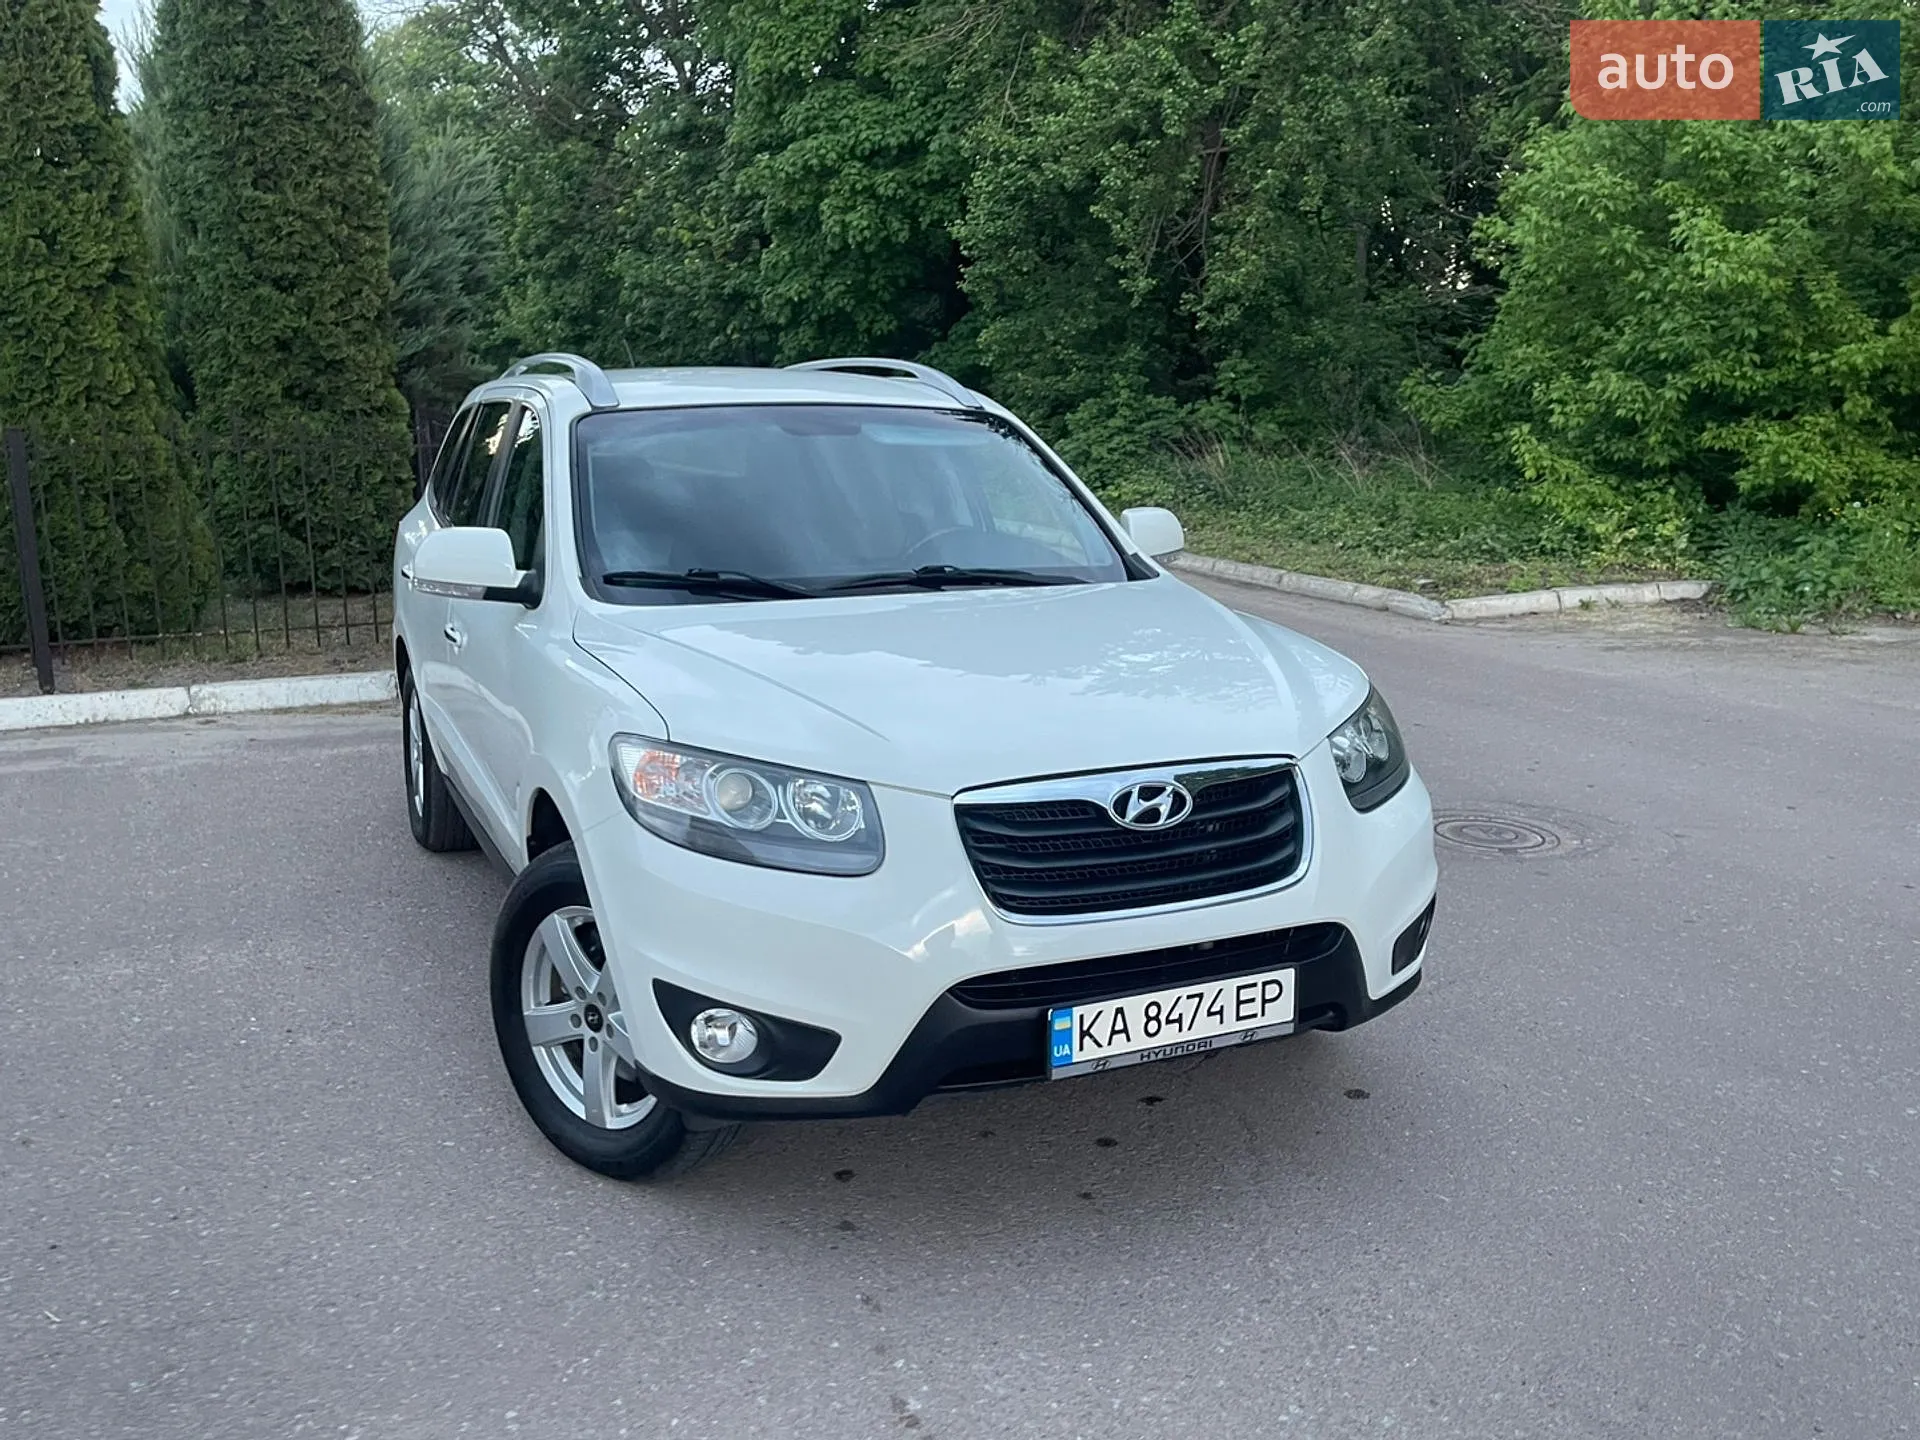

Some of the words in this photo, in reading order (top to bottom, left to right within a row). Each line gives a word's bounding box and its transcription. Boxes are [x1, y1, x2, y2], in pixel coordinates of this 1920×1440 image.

[1078, 1006, 1131, 1052] KA
[1143, 988, 1224, 1039] 8474
[1235, 978, 1283, 1023] EP
[1053, 1044, 1071, 1057] UA
[1139, 1039, 1213, 1062] HYUNDAI
